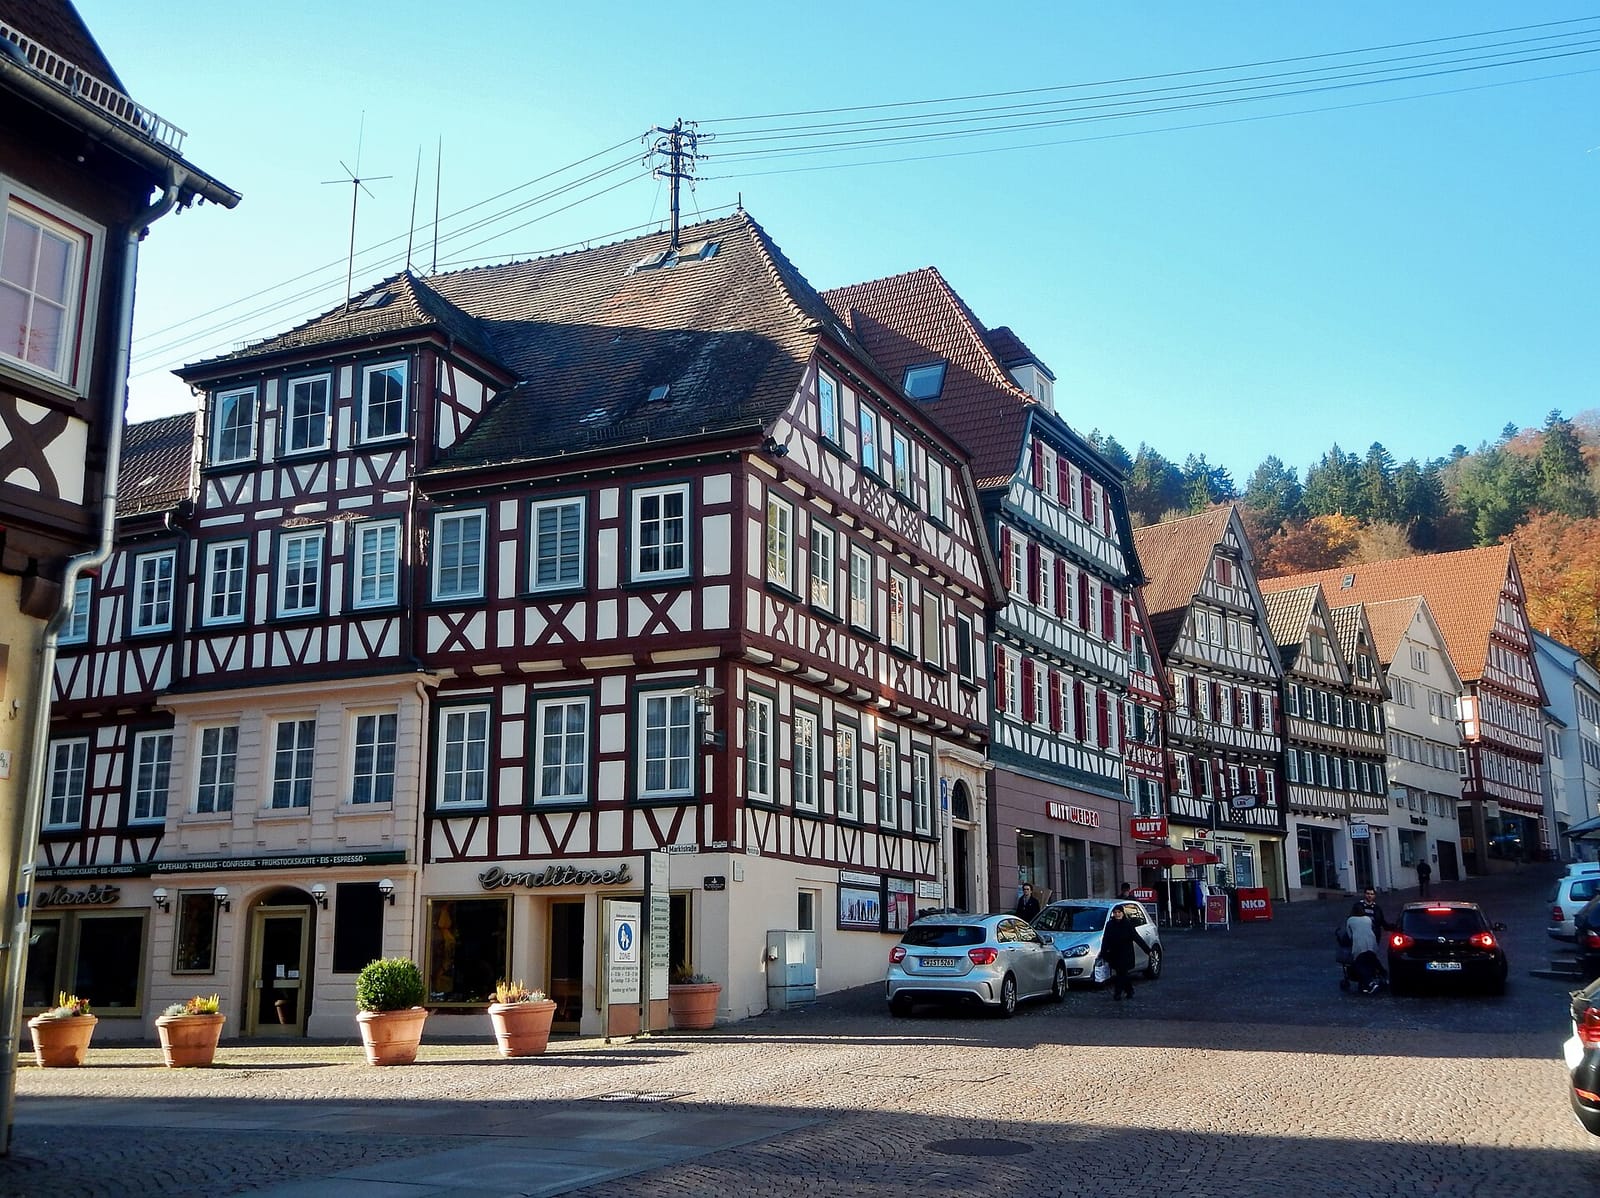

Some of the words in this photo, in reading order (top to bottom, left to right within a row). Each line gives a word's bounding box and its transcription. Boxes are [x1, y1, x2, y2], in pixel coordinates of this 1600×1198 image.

[1048, 802, 1069, 821] WITT
[1070, 806, 1100, 828] WEIDEN
[1136, 822, 1161, 832] WITT
[192, 861, 218, 870] TEEHAUS
[222, 860, 256, 868] CONFISERIE
[320, 856, 330, 864] EIS
[333, 855, 363, 864] ESPRESSO
[478, 863, 633, 890] Conditorei
[36, 884, 120, 908] Markt
[1133, 890, 1153, 898] WITT
[1241, 899, 1266, 909] NKD
[619, 952, 631, 960] ZONE
